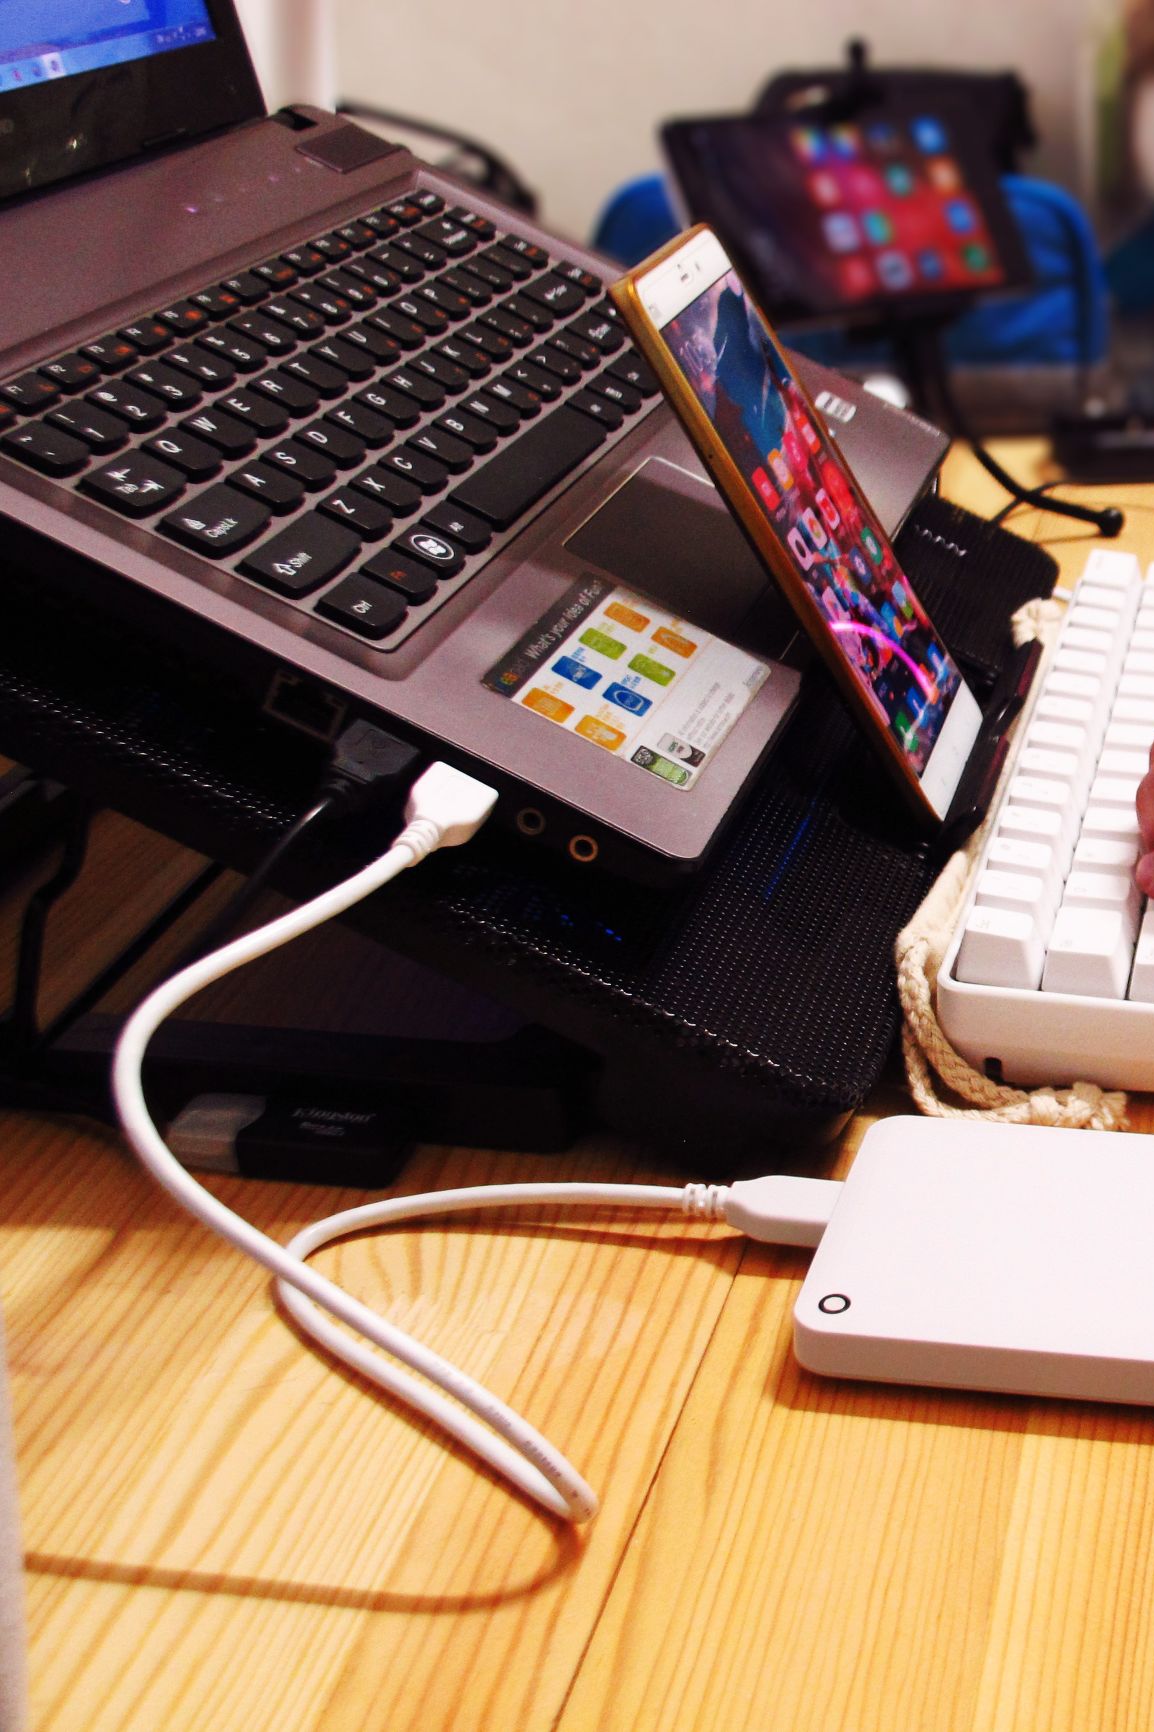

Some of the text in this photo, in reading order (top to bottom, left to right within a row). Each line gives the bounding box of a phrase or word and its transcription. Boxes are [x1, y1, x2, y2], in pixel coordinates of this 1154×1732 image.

[260, 379, 283, 392] R
[228, 398, 251, 412] E
[366, 393, 387, 406] G
[125, 405, 147, 417] 2
[190, 416, 218, 432] W
[306, 431, 328, 444] D
[417, 436, 437, 450] V
[155, 440, 182, 453] Q
[274, 451, 297, 465] S
[392, 456, 413, 470] C
[243, 473, 267, 487] A
[362, 476, 386, 491] X
[333, 499, 355, 514] Z
[288, 552, 314, 568] Shift
[524, 633, 556, 660] What's
[552, 616, 570, 639] your
